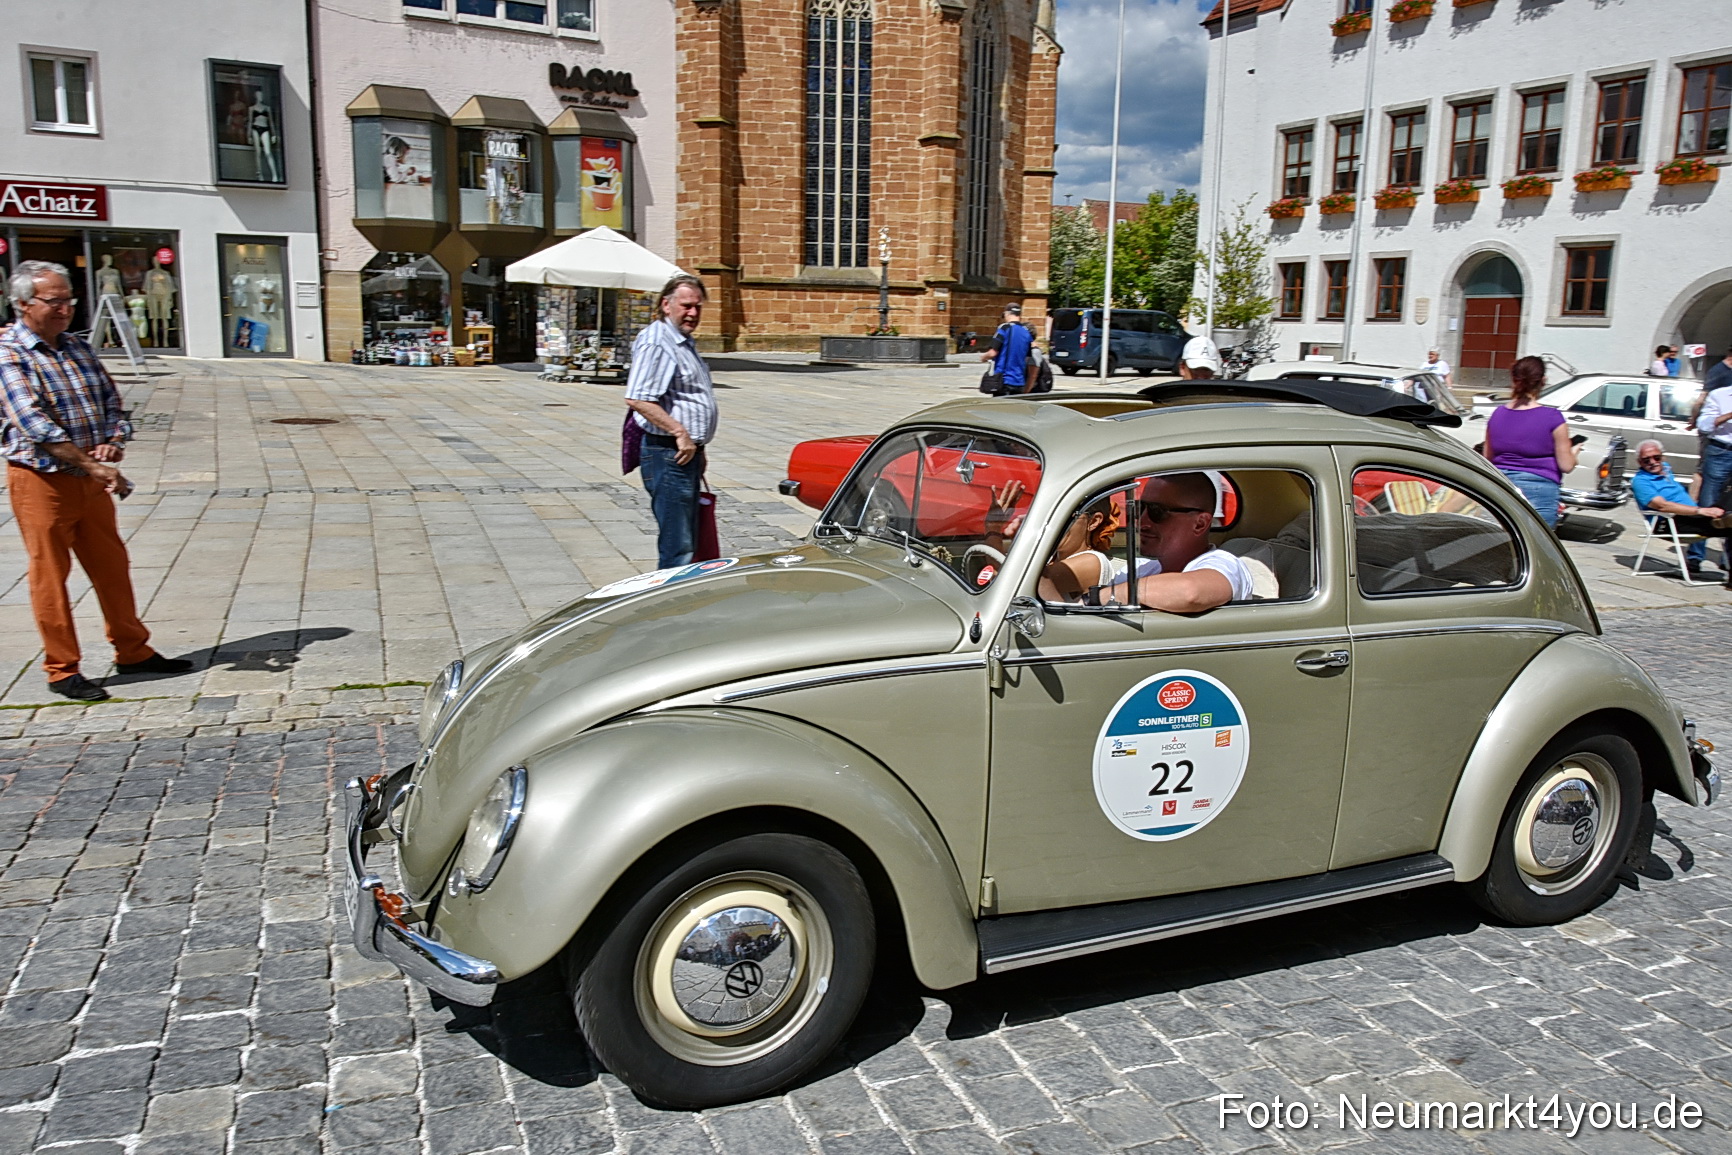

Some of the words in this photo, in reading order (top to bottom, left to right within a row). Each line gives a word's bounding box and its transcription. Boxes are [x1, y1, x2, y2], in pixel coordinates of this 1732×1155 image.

[549, 62, 640, 97] RACKL
[0, 183, 98, 214] Achatz
[1162, 689, 1191, 698] CLASSIC
[1163, 696, 1188, 704] SPRINT
[1138, 714, 1199, 727] SONNLEITNER
[1202, 715, 1210, 724] S
[1161, 742, 1187, 751] HISCOX
[1148, 759, 1194, 796] 22
